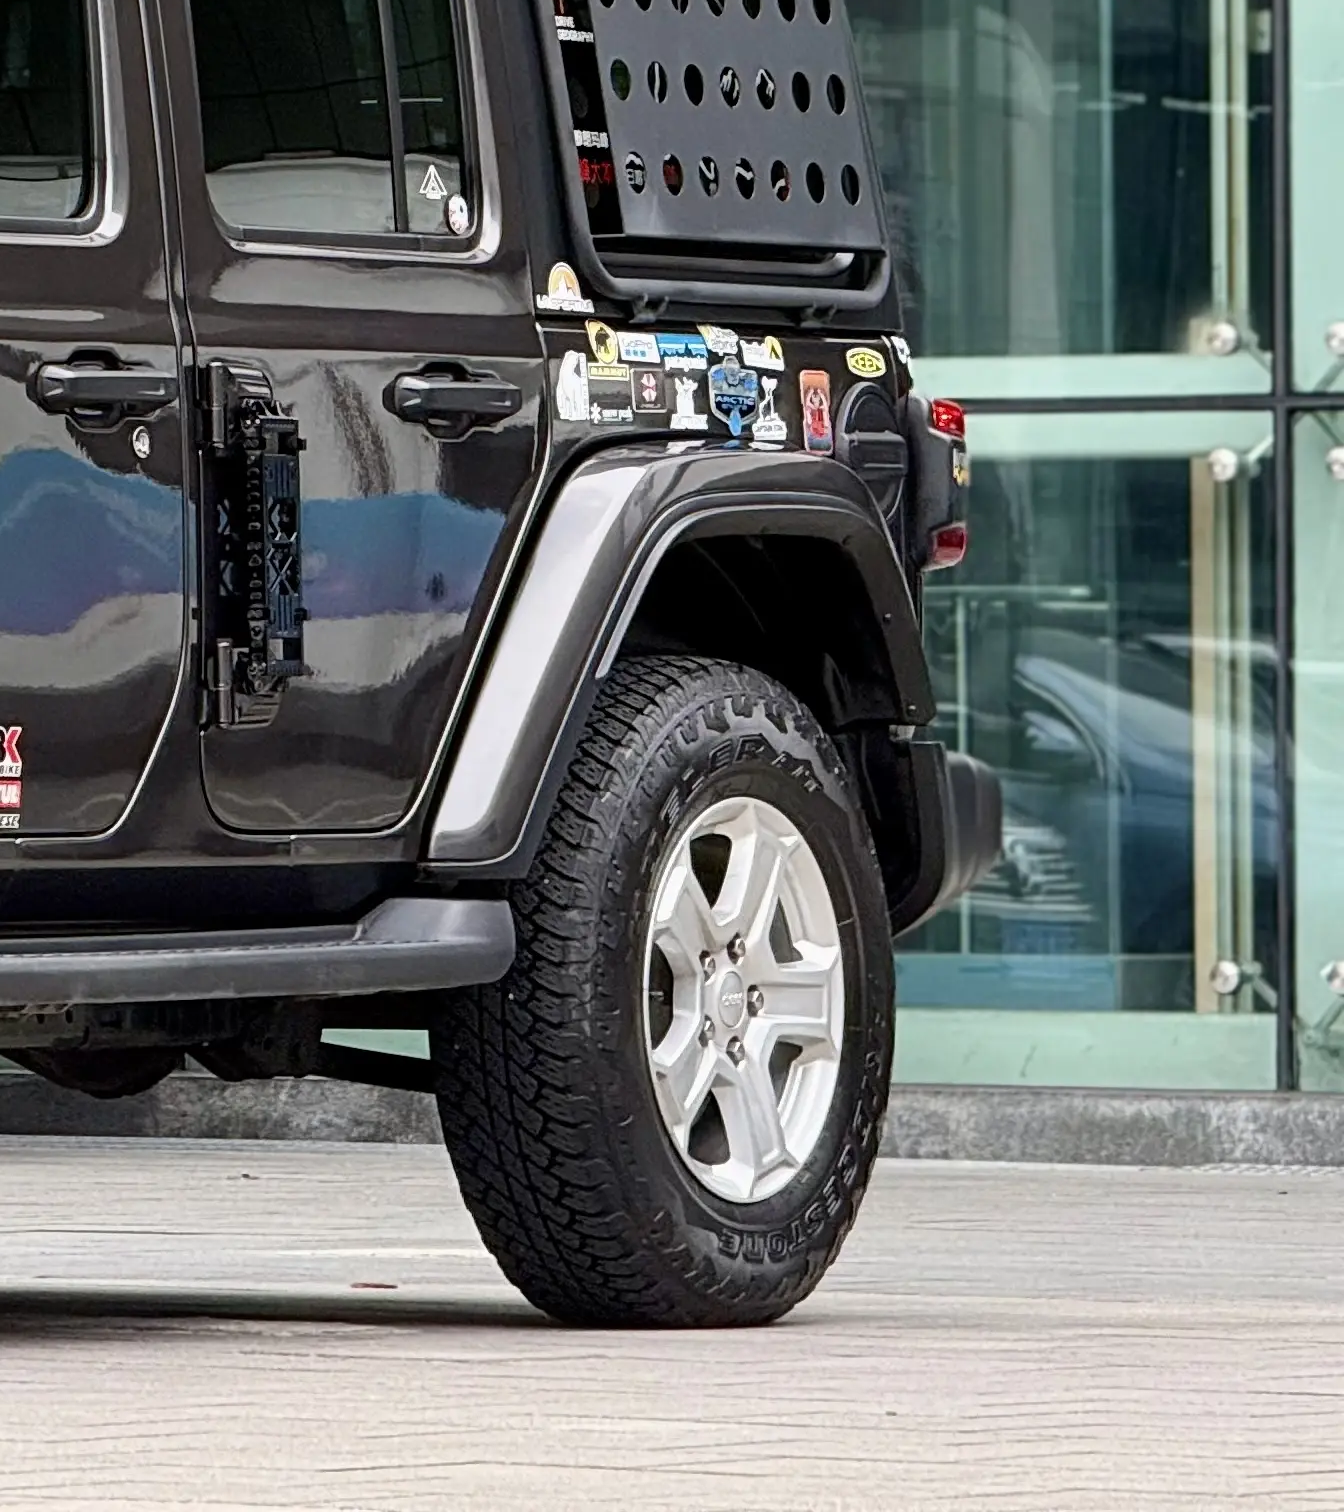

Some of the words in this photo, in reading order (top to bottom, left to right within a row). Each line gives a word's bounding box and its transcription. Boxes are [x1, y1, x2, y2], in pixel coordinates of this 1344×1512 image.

[851, 354, 883, 370] KEEN
[715, 395, 755, 406] ARCTIC
[716, 1010, 885, 1264] RIDGESTONE
